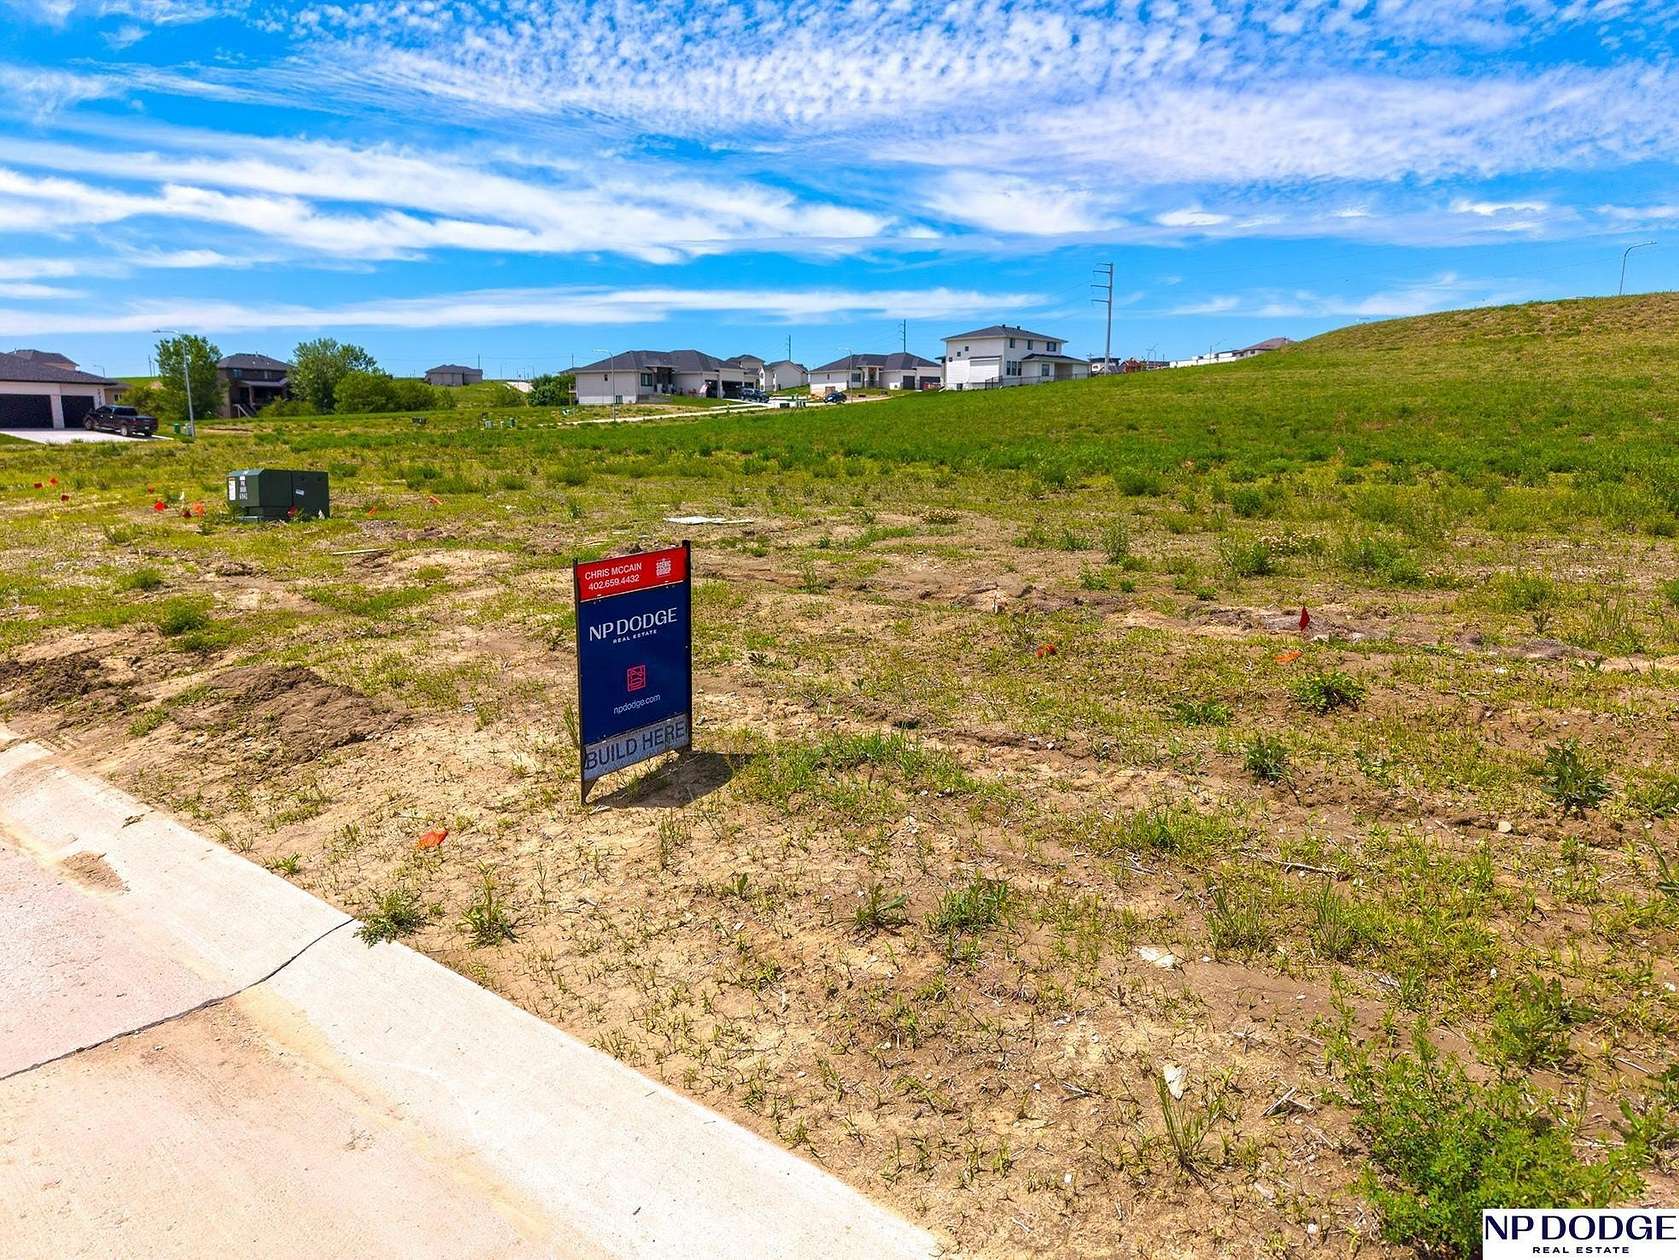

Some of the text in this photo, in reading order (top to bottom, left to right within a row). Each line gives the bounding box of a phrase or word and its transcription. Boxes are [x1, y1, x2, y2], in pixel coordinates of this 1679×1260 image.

[585, 568, 610, 580] CHRIS
[611, 562, 642, 575] MCCAIN
[588, 574, 640, 590] 402.659.4432
[589, 607, 678, 642] NP DODGE
[612, 629, 657, 644] REAL ESTATE
[613, 694, 661, 715] npdodge.com
[585, 720, 685, 770] BUILD HERE
